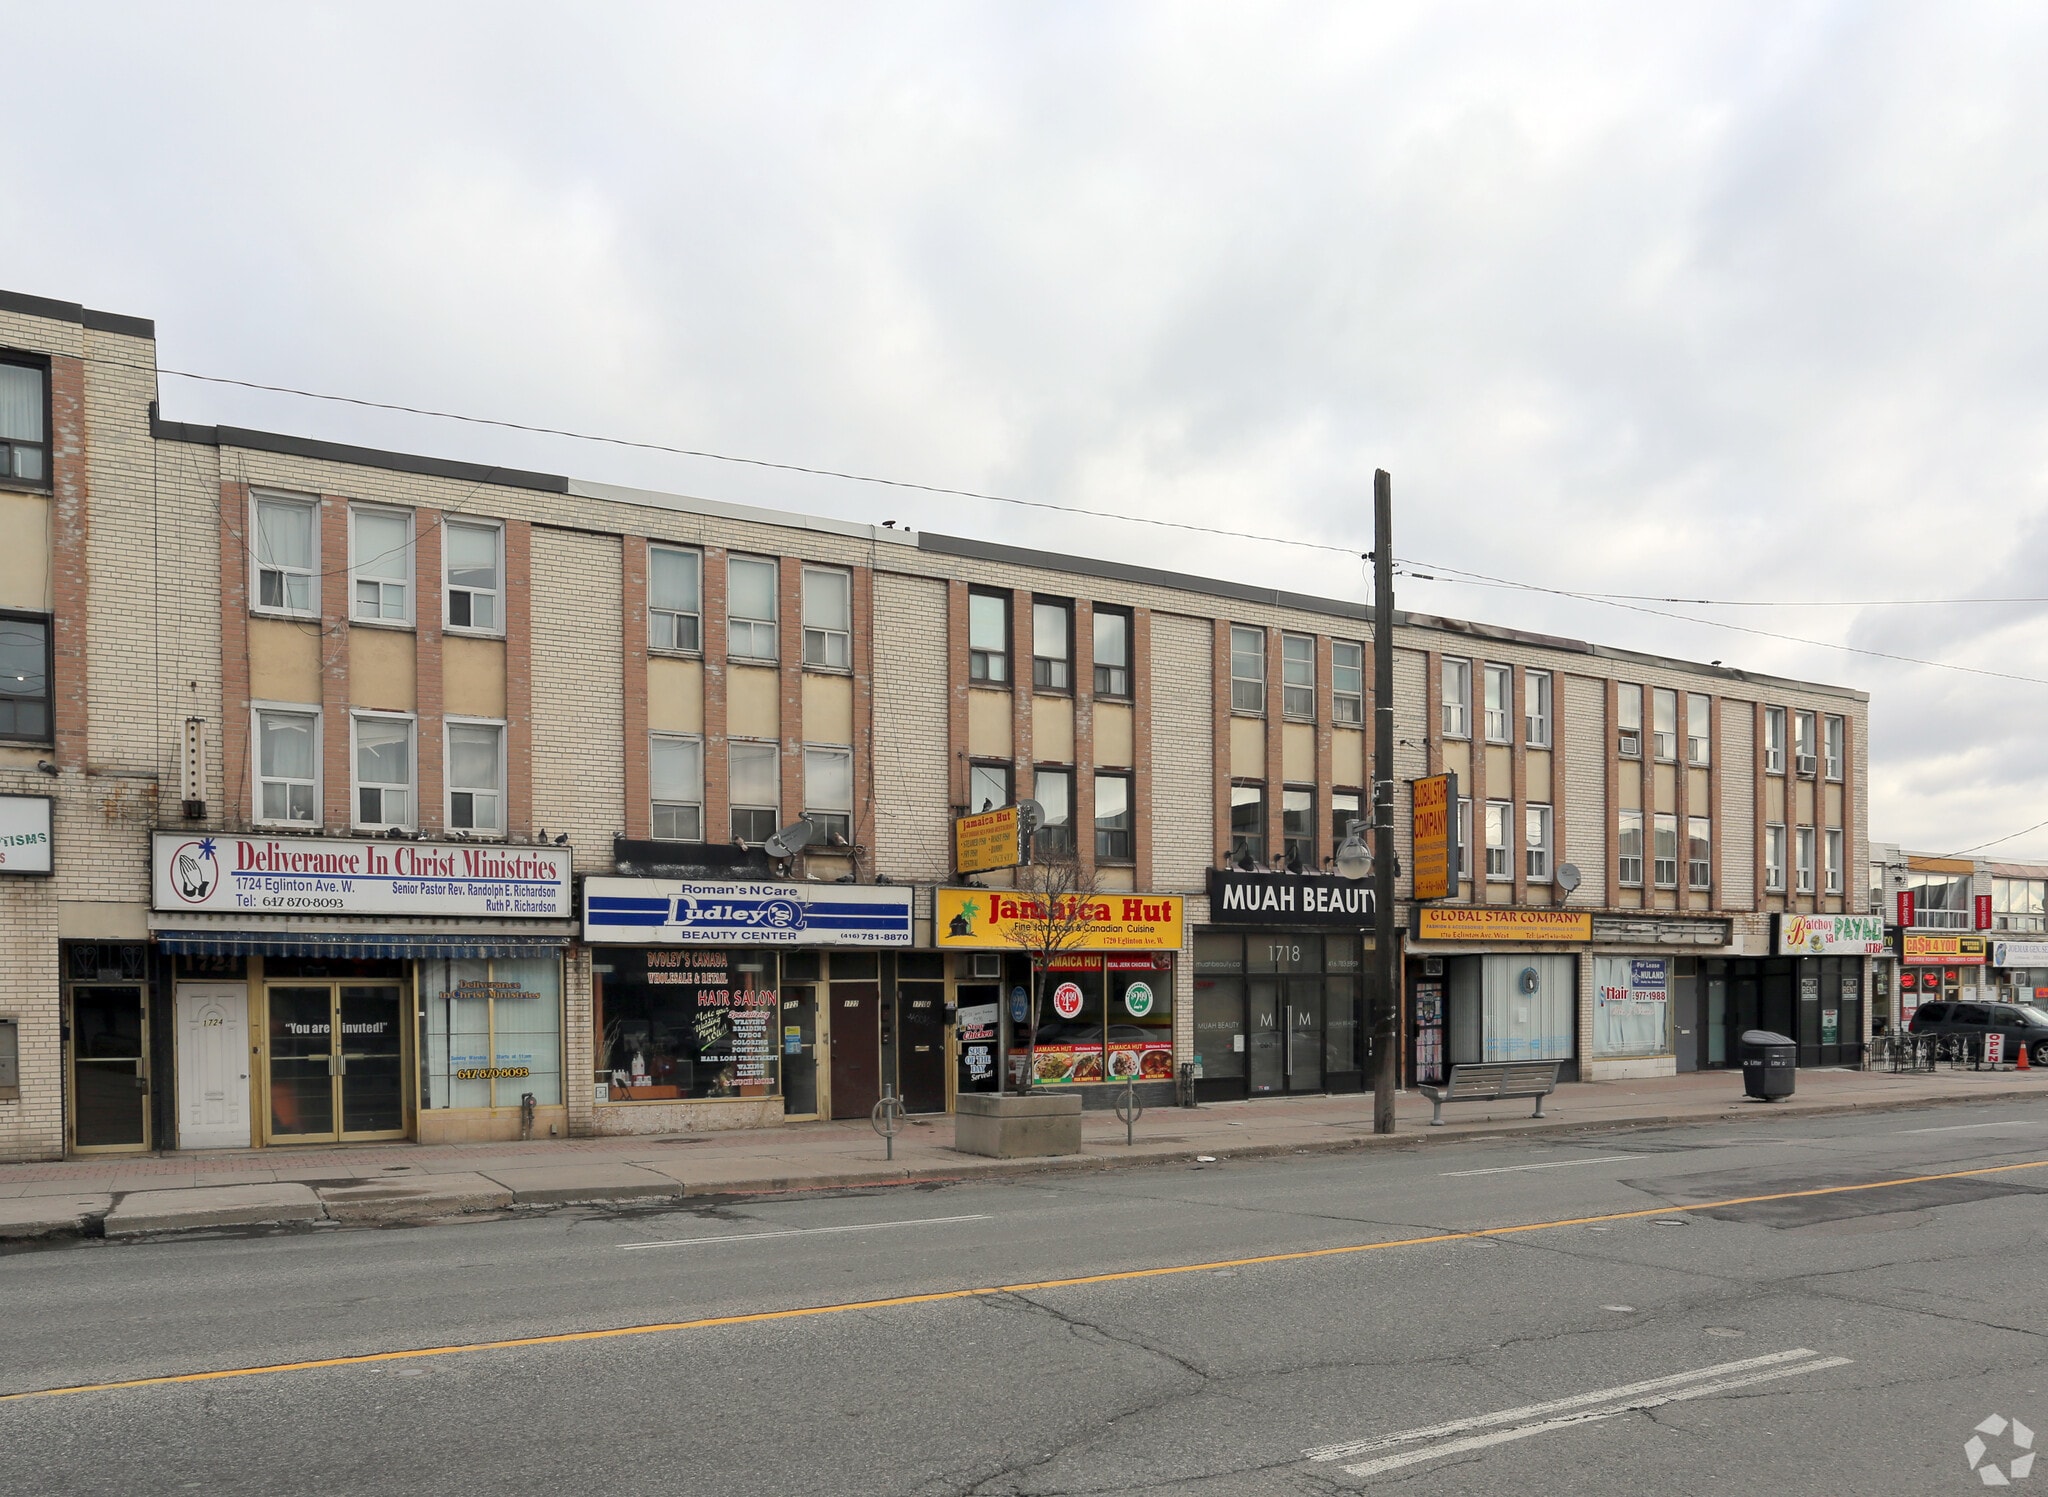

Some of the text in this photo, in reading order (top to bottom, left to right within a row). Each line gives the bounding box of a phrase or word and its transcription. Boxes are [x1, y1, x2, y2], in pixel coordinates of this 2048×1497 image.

[1414, 779, 1447, 808] GLOBAL STAR
[963, 811, 1011, 831] Jamaica Hut
[1414, 809, 1447, 839] COMPANY
[236, 840, 557, 880] Deliverance In Christ Ministries
[236, 877, 355, 894] 1724 Eglinton Ave. W.
[392, 881, 556, 899] Senior Pastor Rev. Randolph E. Richardson
[682, 884, 797, 896] Roman's N Care
[236, 894, 344, 908] Tel: 647 870-8093
[1223, 884, 1376, 913] MUAH BEAUTY
[486, 899, 557, 913] Ruth P. Richardson
[989, 894, 1172, 924] Jamaica Hut
[1430, 910, 1581, 923] GLOBAL STAR COMPANY
[1014, 922, 1031, 931] Fine
[1075, 924, 1081, 932] &
[1084, 923, 1123, 933] Canadian
[1127, 924, 1155, 933] Cuisine
[682, 931, 797, 940] BEAUTY CENTER
[861, 933, 909, 941] 781-8870
[1117, 936, 1142, 945] Eglinton
[1825, 933, 1834, 943] sa
[1864, 942, 1883, 953] ATBP
[1906, 937, 1931, 953] CA$H
[1933, 940, 1939, 951] 4
[1941, 940, 1957, 951] YOU
[646, 951, 728, 967] DUDLEY'S CANADA
[1268, 945, 1301, 962] 1718
[1046, 956, 1102, 967] AMAICA HUT
[647, 972, 728, 984] WHOLESALE & RETAIL
[1640, 971, 1664, 980] NULAND
[459, 980, 521, 989] Deliverance
[1802, 986, 1816, 994] RENT
[1842, 986, 1856, 994] RENT
[451, 989, 486, 999] Christ
[488, 989, 541, 999] Ministries
[697, 989, 777, 1006] HAIR SALON
[1606, 985, 1629, 1000] Hair
[203, 1018, 224, 1027] 1724
[1198, 1021, 1239, 1030] MUAH BEAUTY
[1260, 1012, 1311, 1027] M M
[312, 1023, 331, 1034] are
[963, 1030, 994, 1040] Chicken
[968, 1046, 988, 1055] SOUP
[1035, 1045, 1059, 1053] JAMAICA
[1988, 1033, 2001, 1062] OPEN
[965, 1055, 991, 1065] OF THE
[457, 1067, 529, 1080] 647 870-8093
[970, 1065, 986, 1073] DAY
